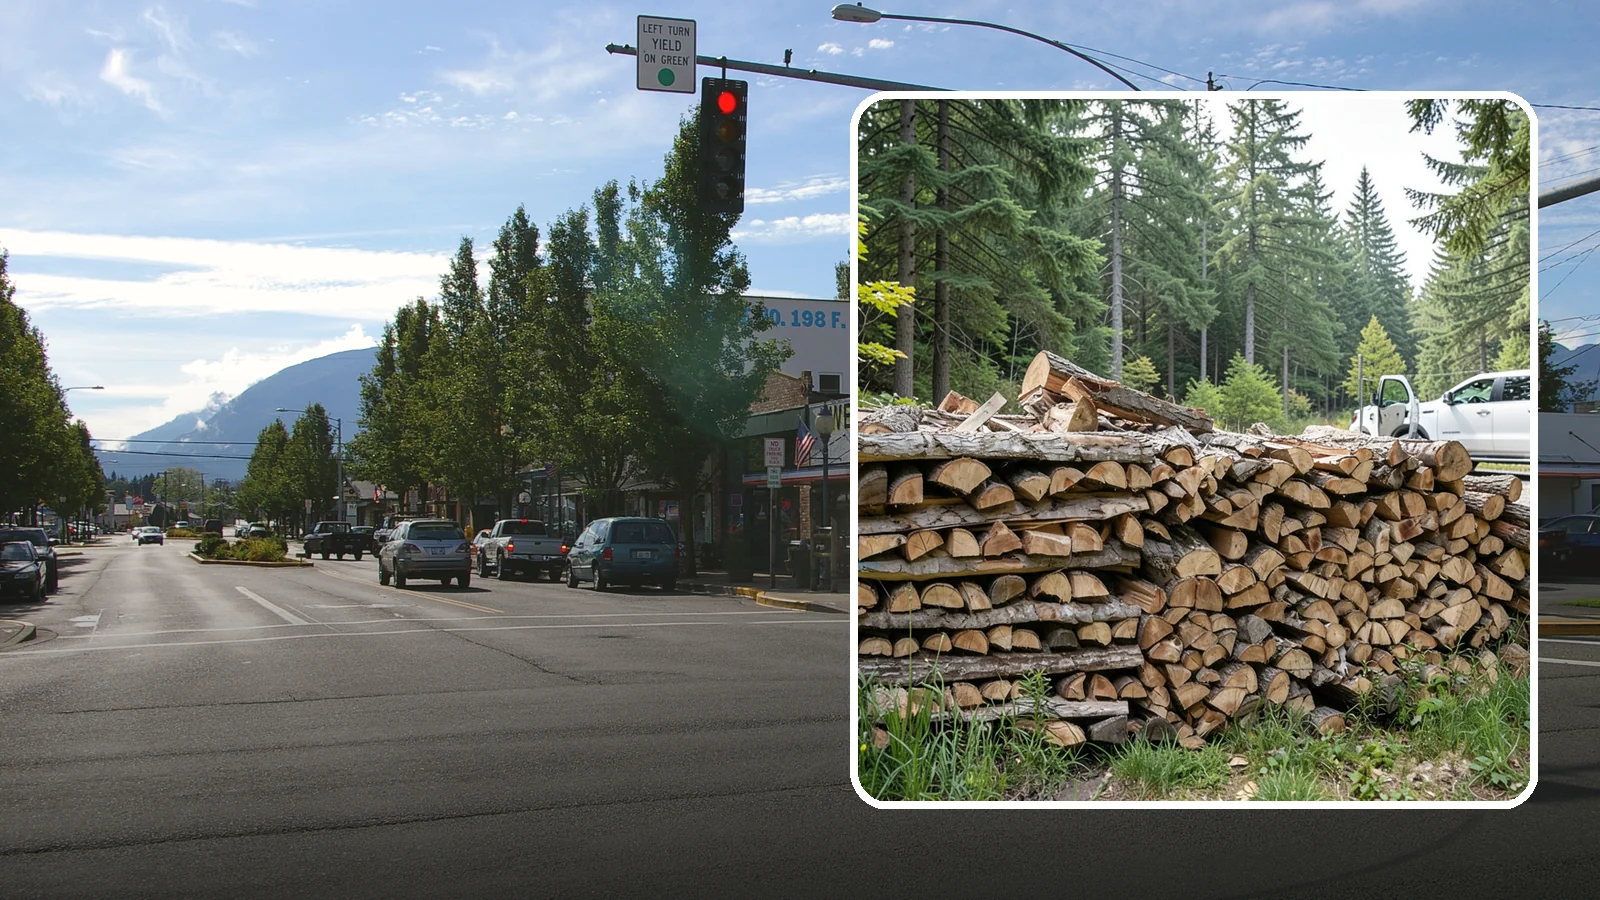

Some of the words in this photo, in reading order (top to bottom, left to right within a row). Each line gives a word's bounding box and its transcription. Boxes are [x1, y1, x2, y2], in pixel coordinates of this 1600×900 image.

[643, 24, 663, 34] LEFT
[668, 26, 690, 36] TURN
[652, 38, 682, 52] YIELD
[644, 53, 656, 64] ON
[661, 54, 689, 66] GREEN
[791, 309, 826, 328] 198
[831, 311, 847, 329] F.
